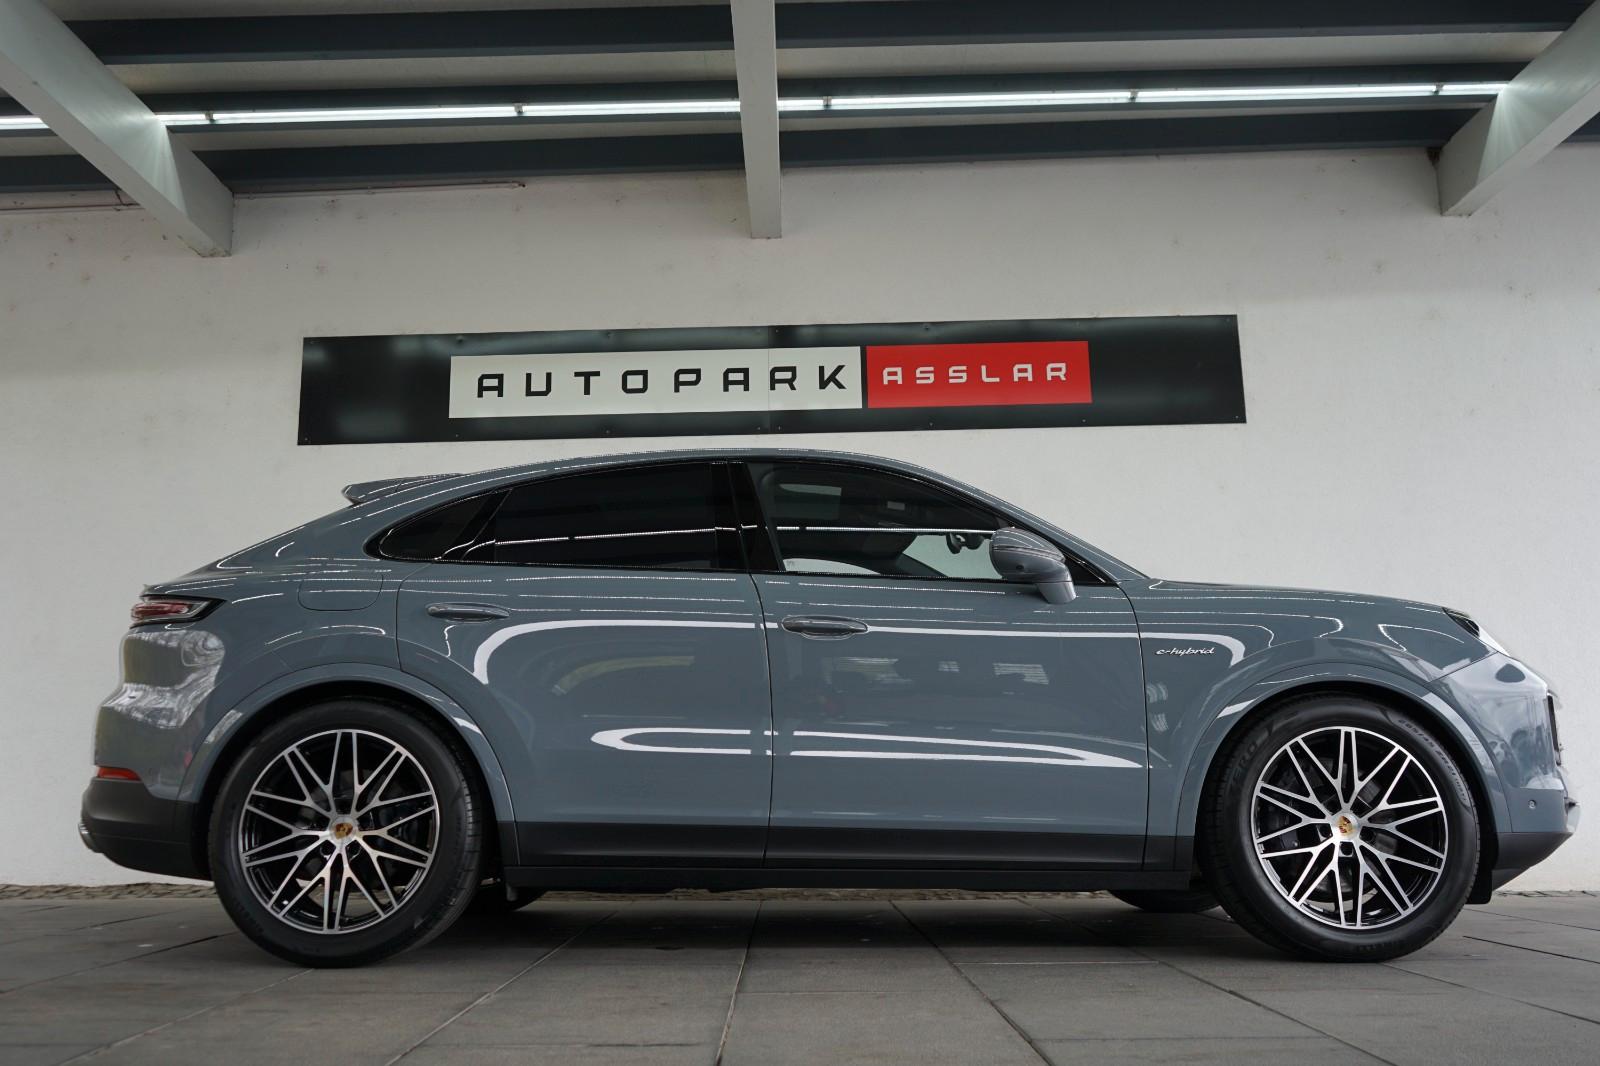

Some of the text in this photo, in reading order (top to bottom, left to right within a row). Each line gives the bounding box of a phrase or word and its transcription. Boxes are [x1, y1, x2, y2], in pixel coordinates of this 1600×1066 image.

[477, 362, 1067, 398] AUTOPARK ASSLAR
[1155, 647, 1216, 657] e-hybrid
